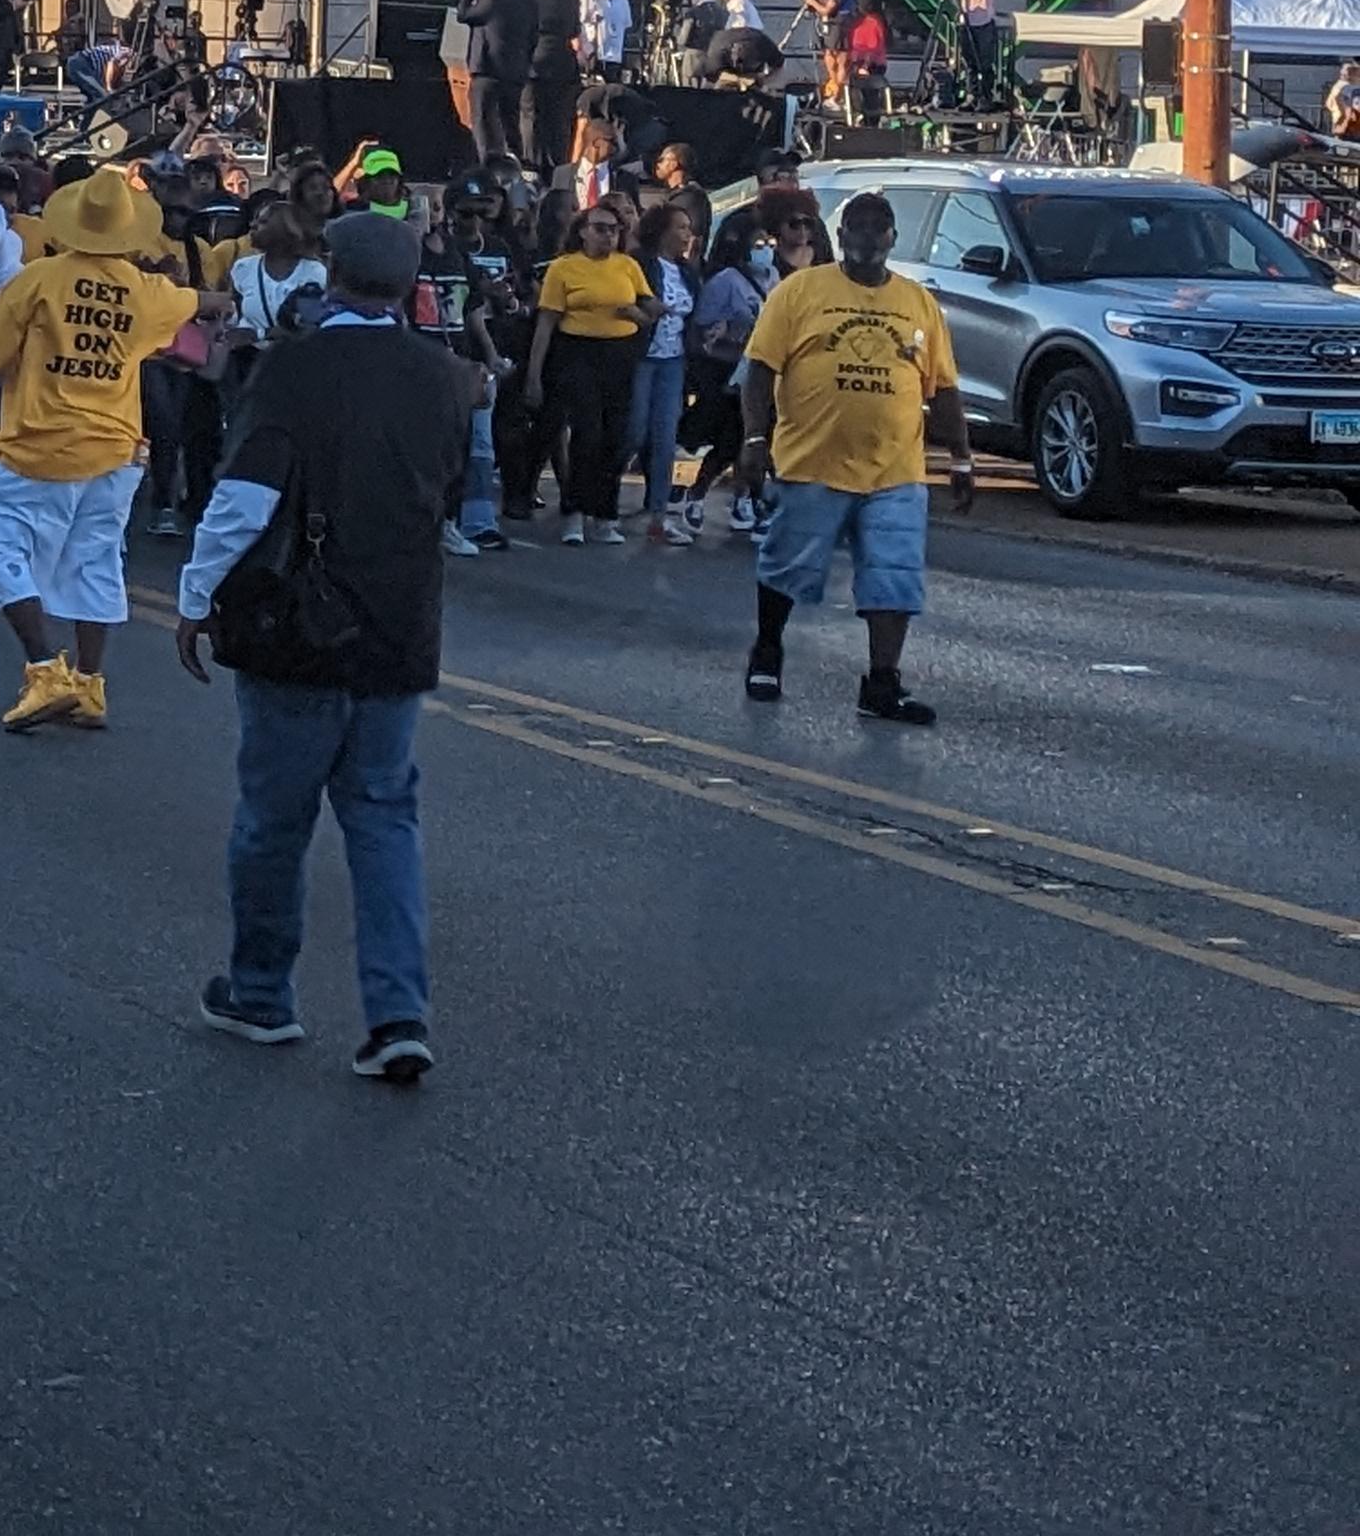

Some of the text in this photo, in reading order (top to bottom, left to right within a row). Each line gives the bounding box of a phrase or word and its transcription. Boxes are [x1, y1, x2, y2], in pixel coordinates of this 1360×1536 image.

[74, 278, 130, 306] GET
[63, 304, 134, 333] HIGH
[74, 332, 113, 354] ON
[45, 355, 124, 381] JESUS
[837, 363, 891, 377] SOCIETY
